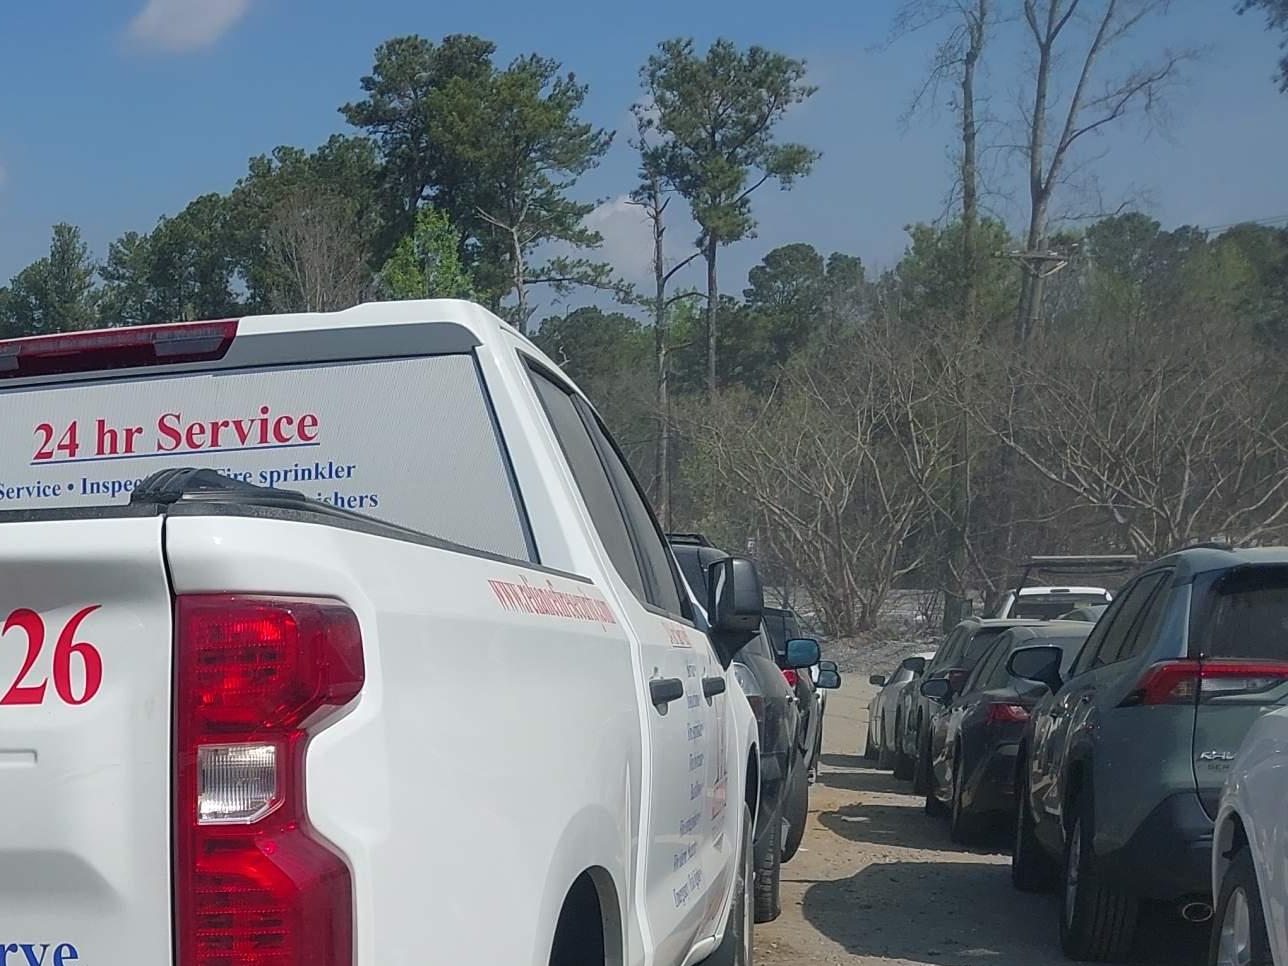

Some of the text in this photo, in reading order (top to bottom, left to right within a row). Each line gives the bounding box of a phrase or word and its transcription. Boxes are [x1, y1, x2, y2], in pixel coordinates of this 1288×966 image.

[33, 406, 319, 460] 24 hr Service
[259, 462, 356, 486] sprinkler
